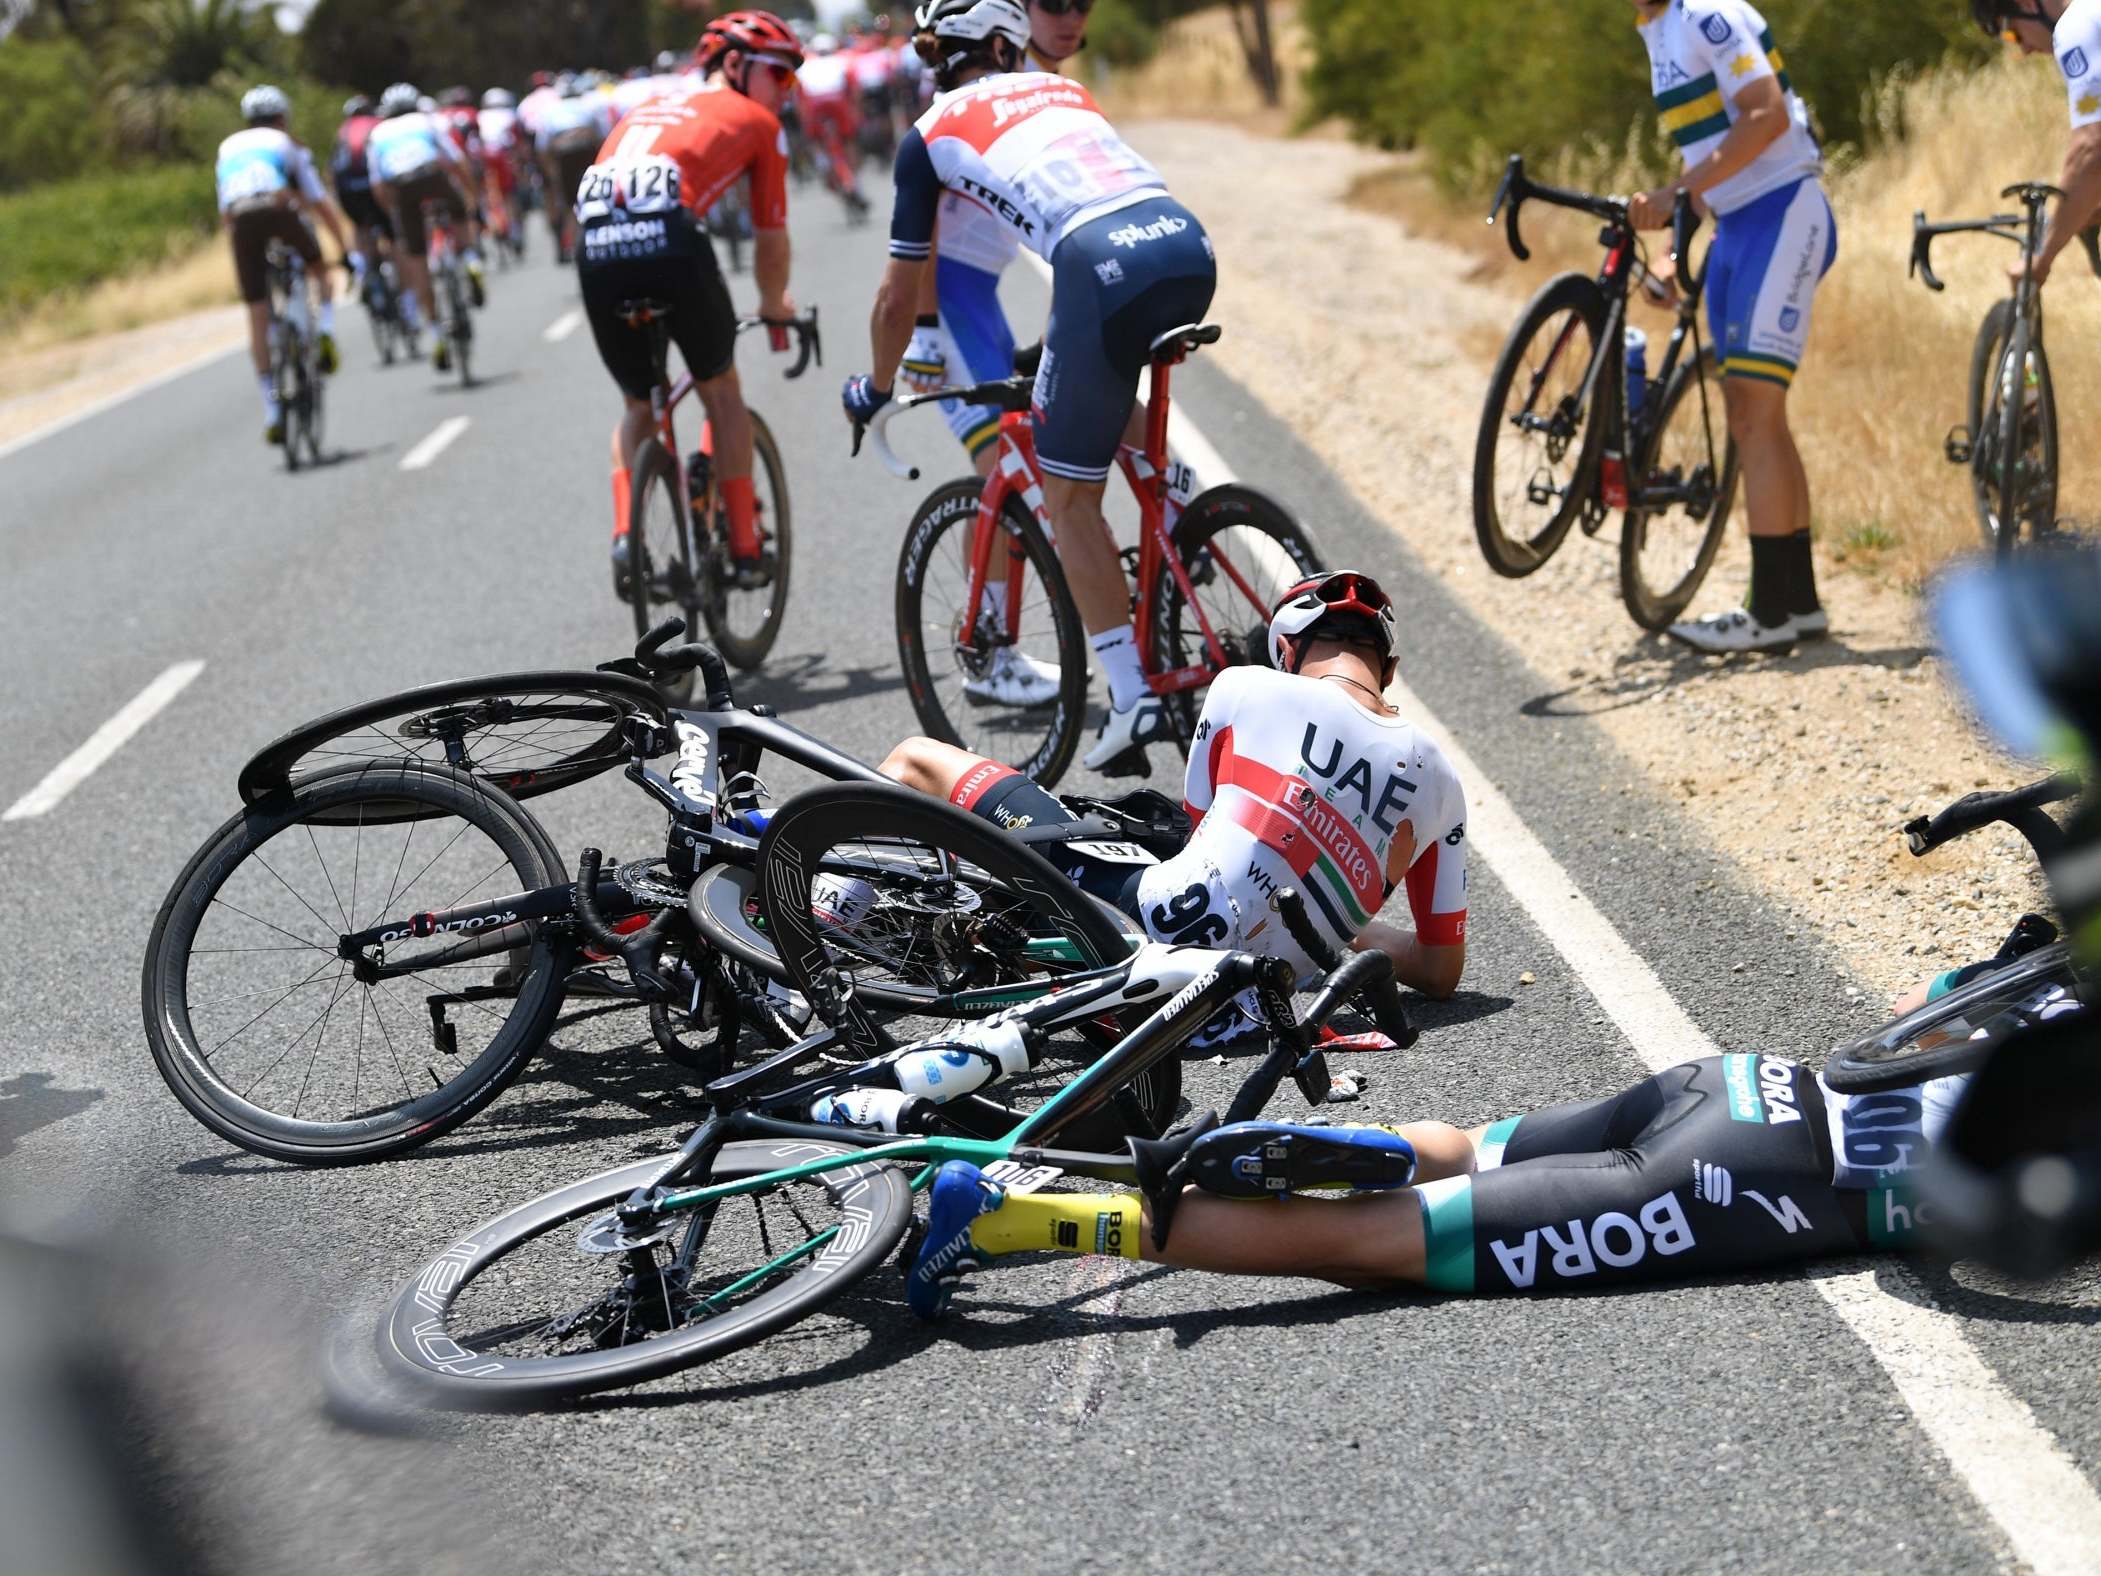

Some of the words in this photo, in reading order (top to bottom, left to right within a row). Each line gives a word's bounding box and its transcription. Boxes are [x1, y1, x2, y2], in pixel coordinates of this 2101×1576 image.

[959, 175, 1035, 237] TREK
[1173, 463, 1190, 494] 16
[1301, 722, 1418, 837] UAE
[1088, 843, 1141, 858] 197
[1283, 781, 1373, 892] Emirates
[380, 910, 506, 943] COLNGO
[1488, 1190, 1697, 1289] BORA
